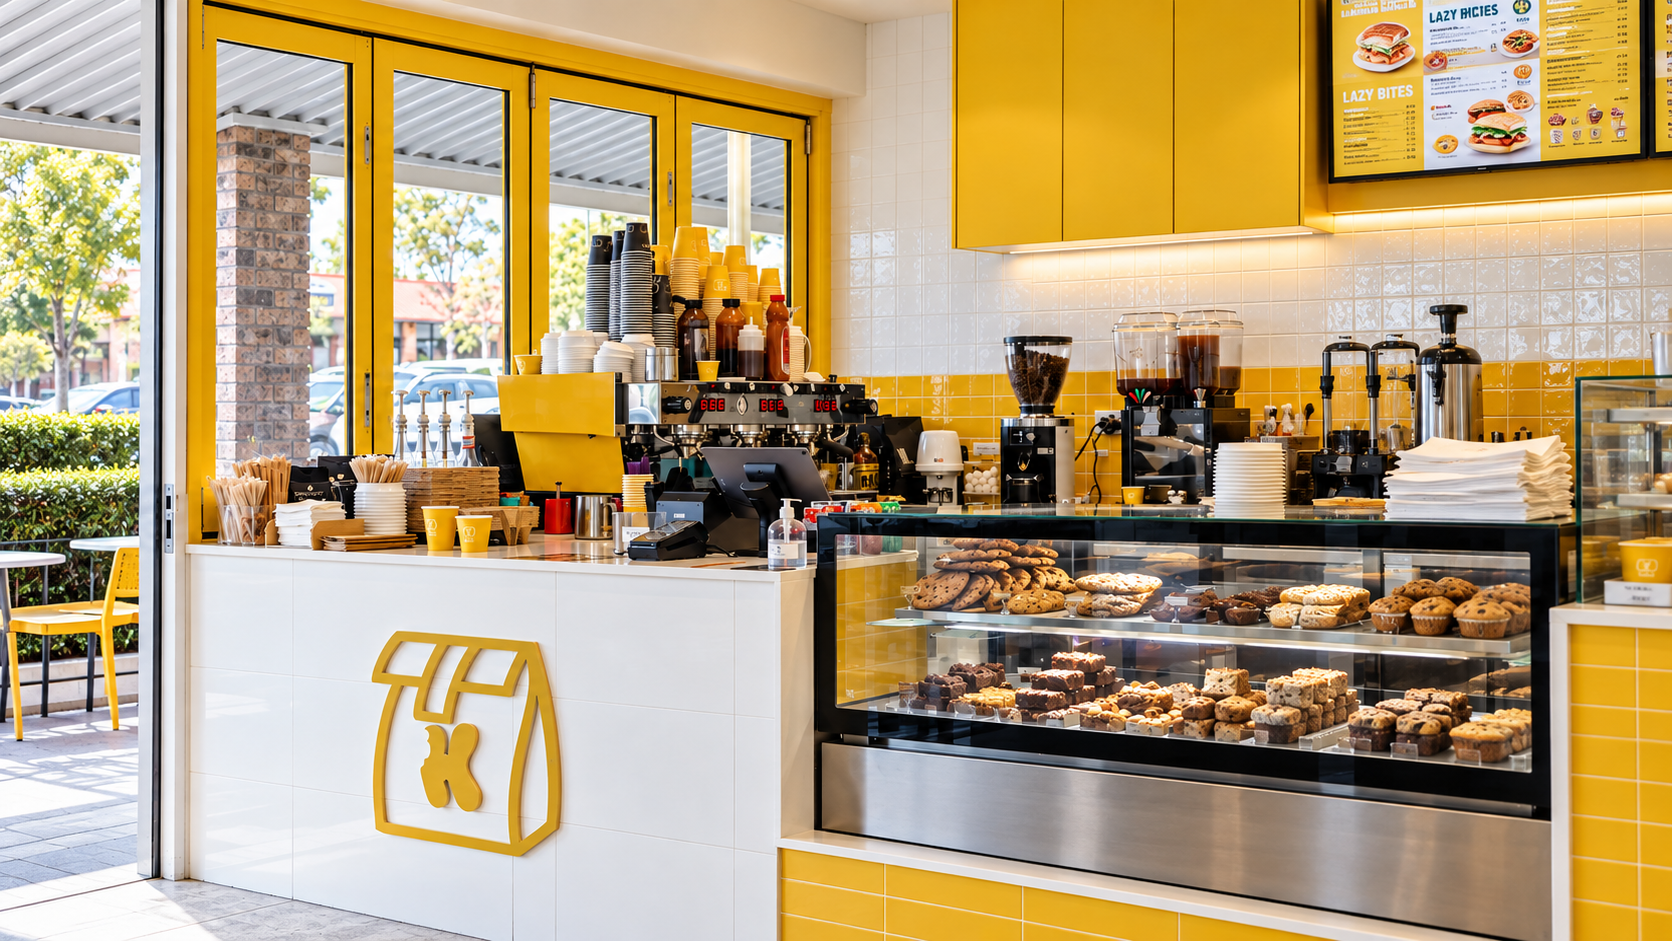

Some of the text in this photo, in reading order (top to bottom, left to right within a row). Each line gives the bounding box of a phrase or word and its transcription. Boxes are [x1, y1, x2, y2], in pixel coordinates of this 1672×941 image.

[1429, 9, 1457, 23] LAZY
[1343, 88, 1374, 103] LAZY
[1378, 84, 1413, 100] BITES
